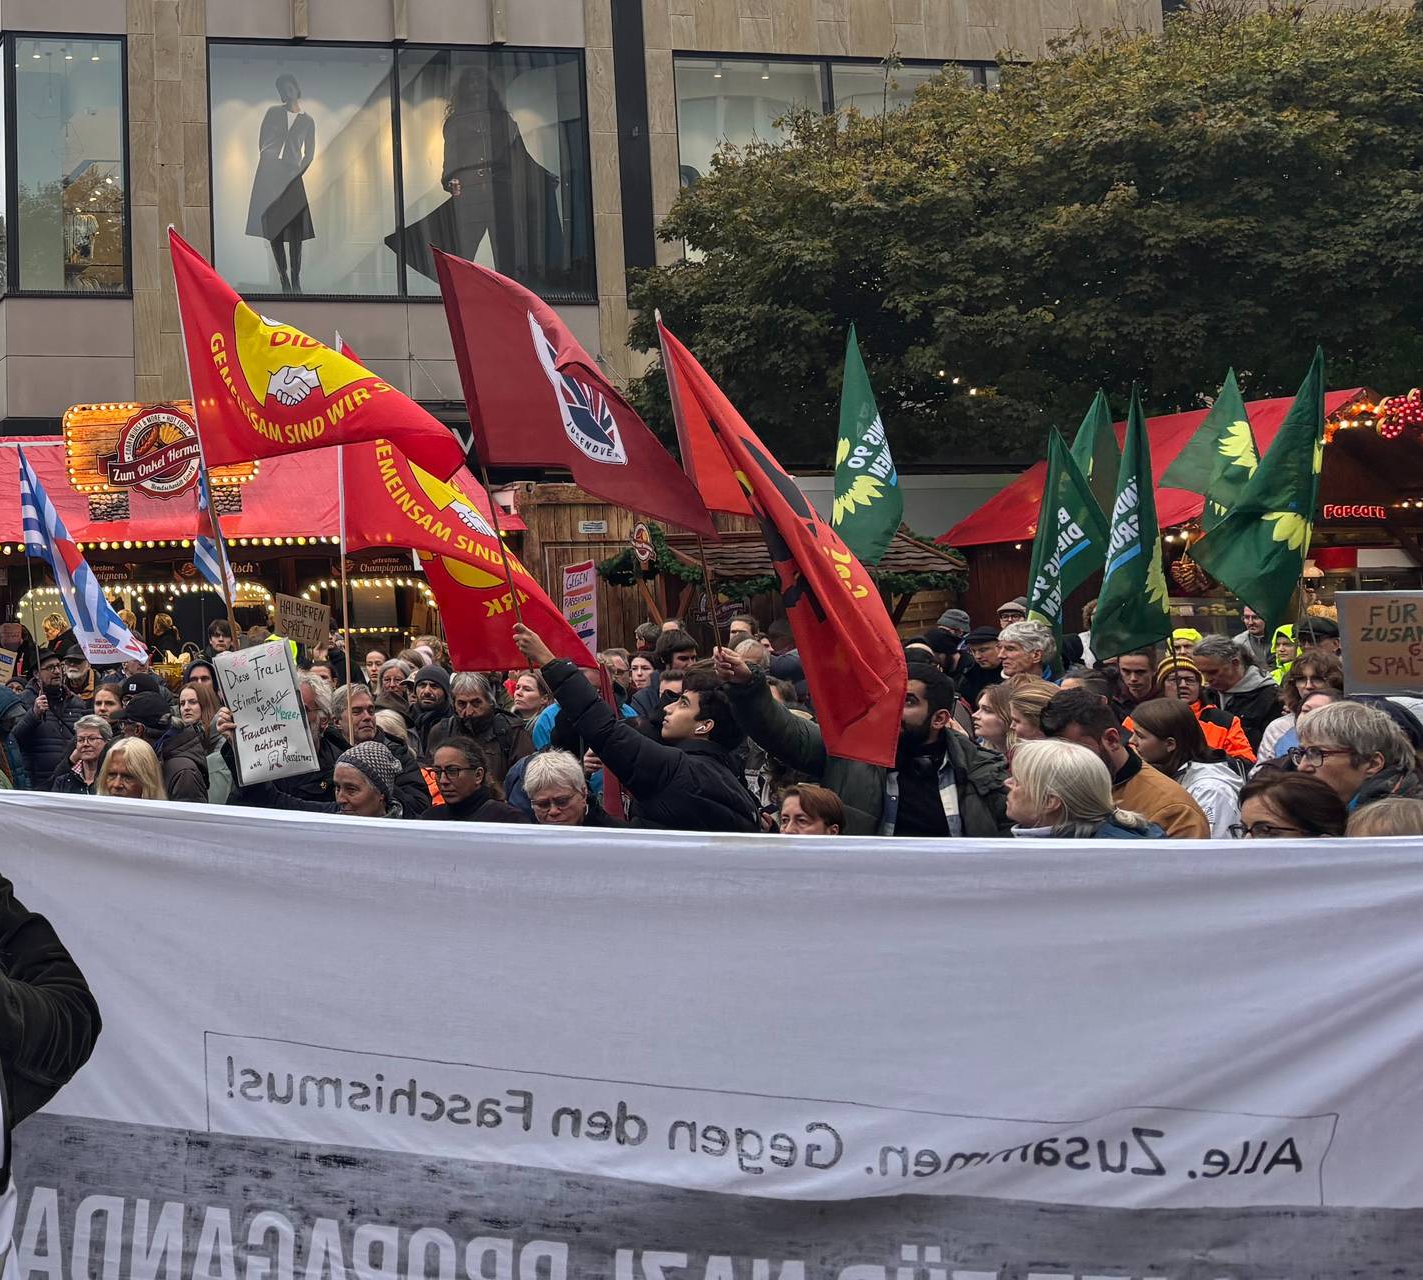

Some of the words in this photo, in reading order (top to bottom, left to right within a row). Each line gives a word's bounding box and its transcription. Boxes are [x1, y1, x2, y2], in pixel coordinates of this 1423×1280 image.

[284, 415, 325, 445] SIND
[326, 388, 373, 427] WIR
[113, 468, 136, 482] Zum
[138, 459, 165, 477] Onkel
[167, 442, 201, 462] Herma
[453, 534, 504, 565] SIND
[360, 563, 412, 573] Champignons
[565, 571, 589, 590] GEGEN
[279, 600, 325, 623] HALBIEREN
[1369, 600, 1418, 626] FÜR
[225, 669, 250, 689] Diese
[248, 654, 286, 681] Frau
[256, 688, 290, 721] gegen
[254, 736, 288, 753] achtung
